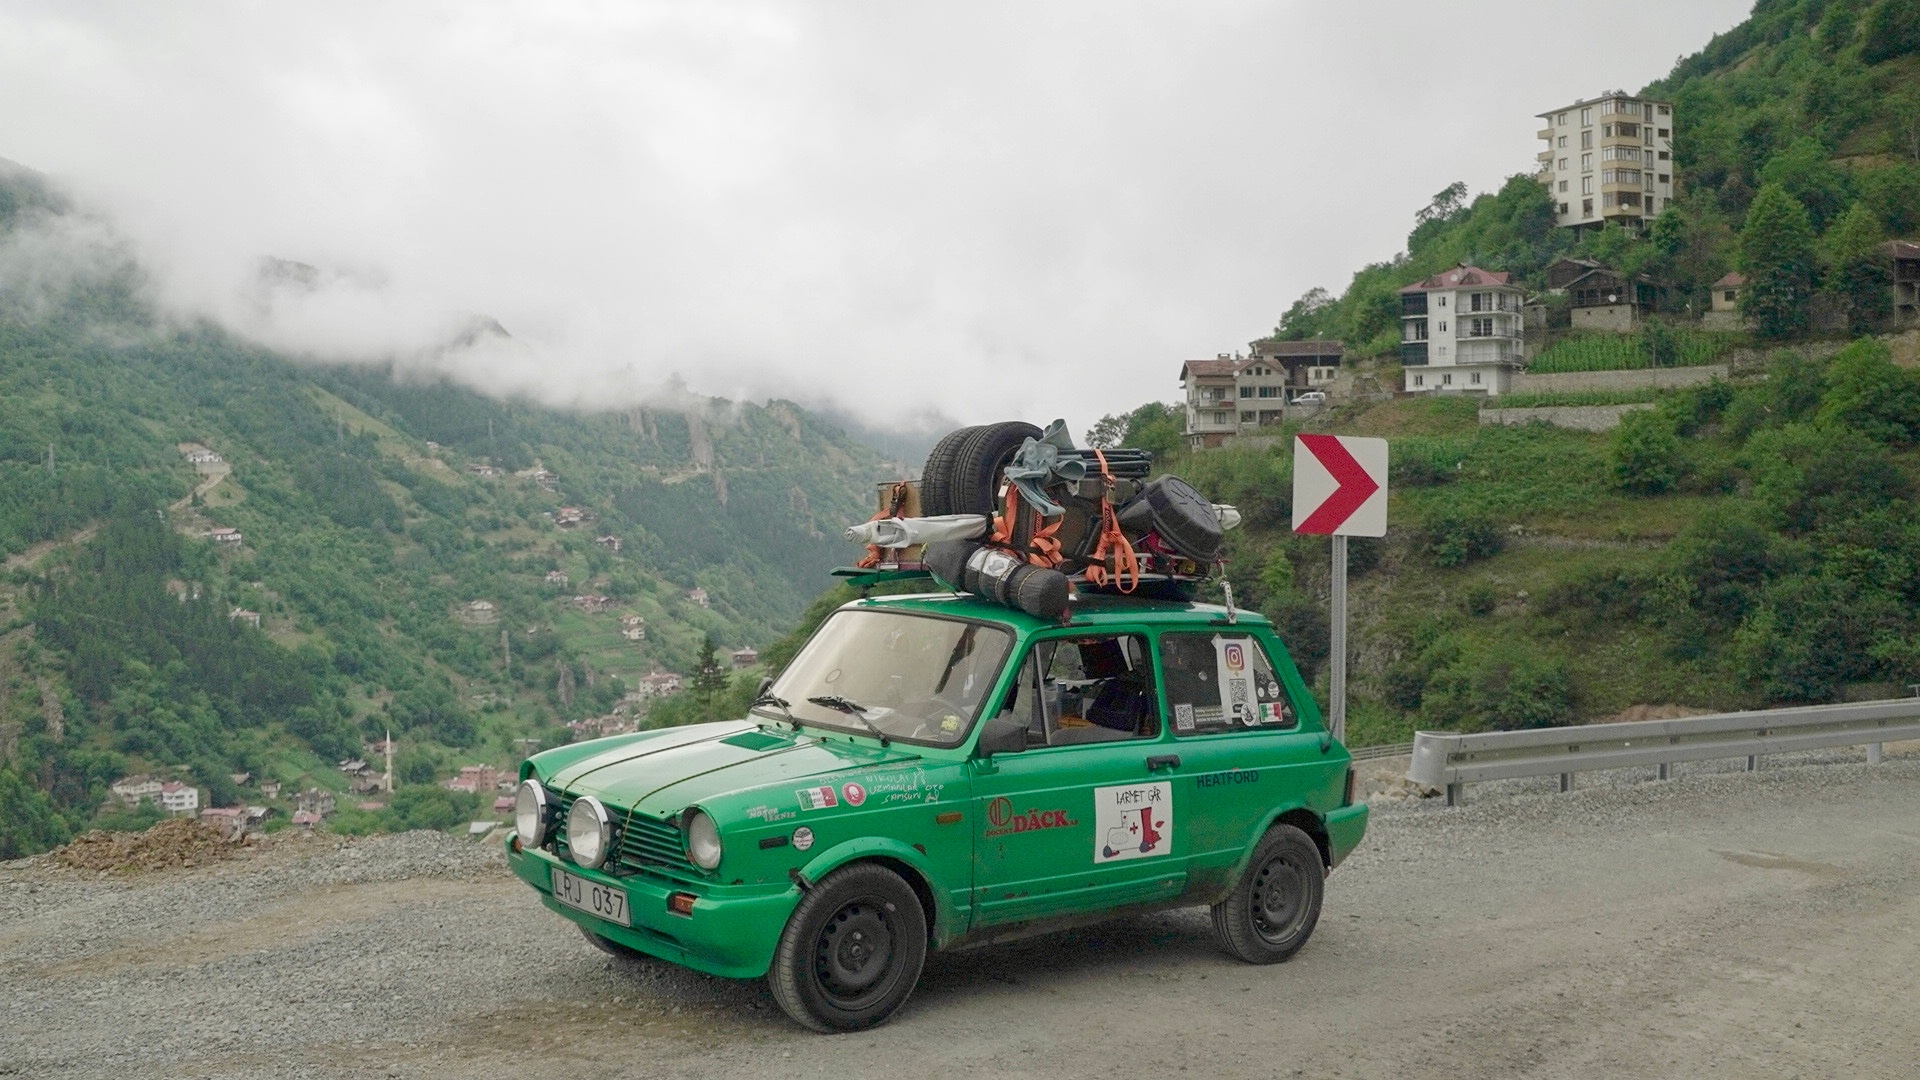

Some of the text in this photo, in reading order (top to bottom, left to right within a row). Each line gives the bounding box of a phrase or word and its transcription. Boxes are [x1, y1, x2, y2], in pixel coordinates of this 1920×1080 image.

[865, 773, 909, 784] NIKOLAI
[1196, 770, 1259, 788] HEATFORD
[1116, 789, 1145, 805] LARMET
[749, 807, 779, 819] MOTOR
[1013, 808, 1069, 832] DÄCK
[553, 871, 623, 918] LRJ 037
